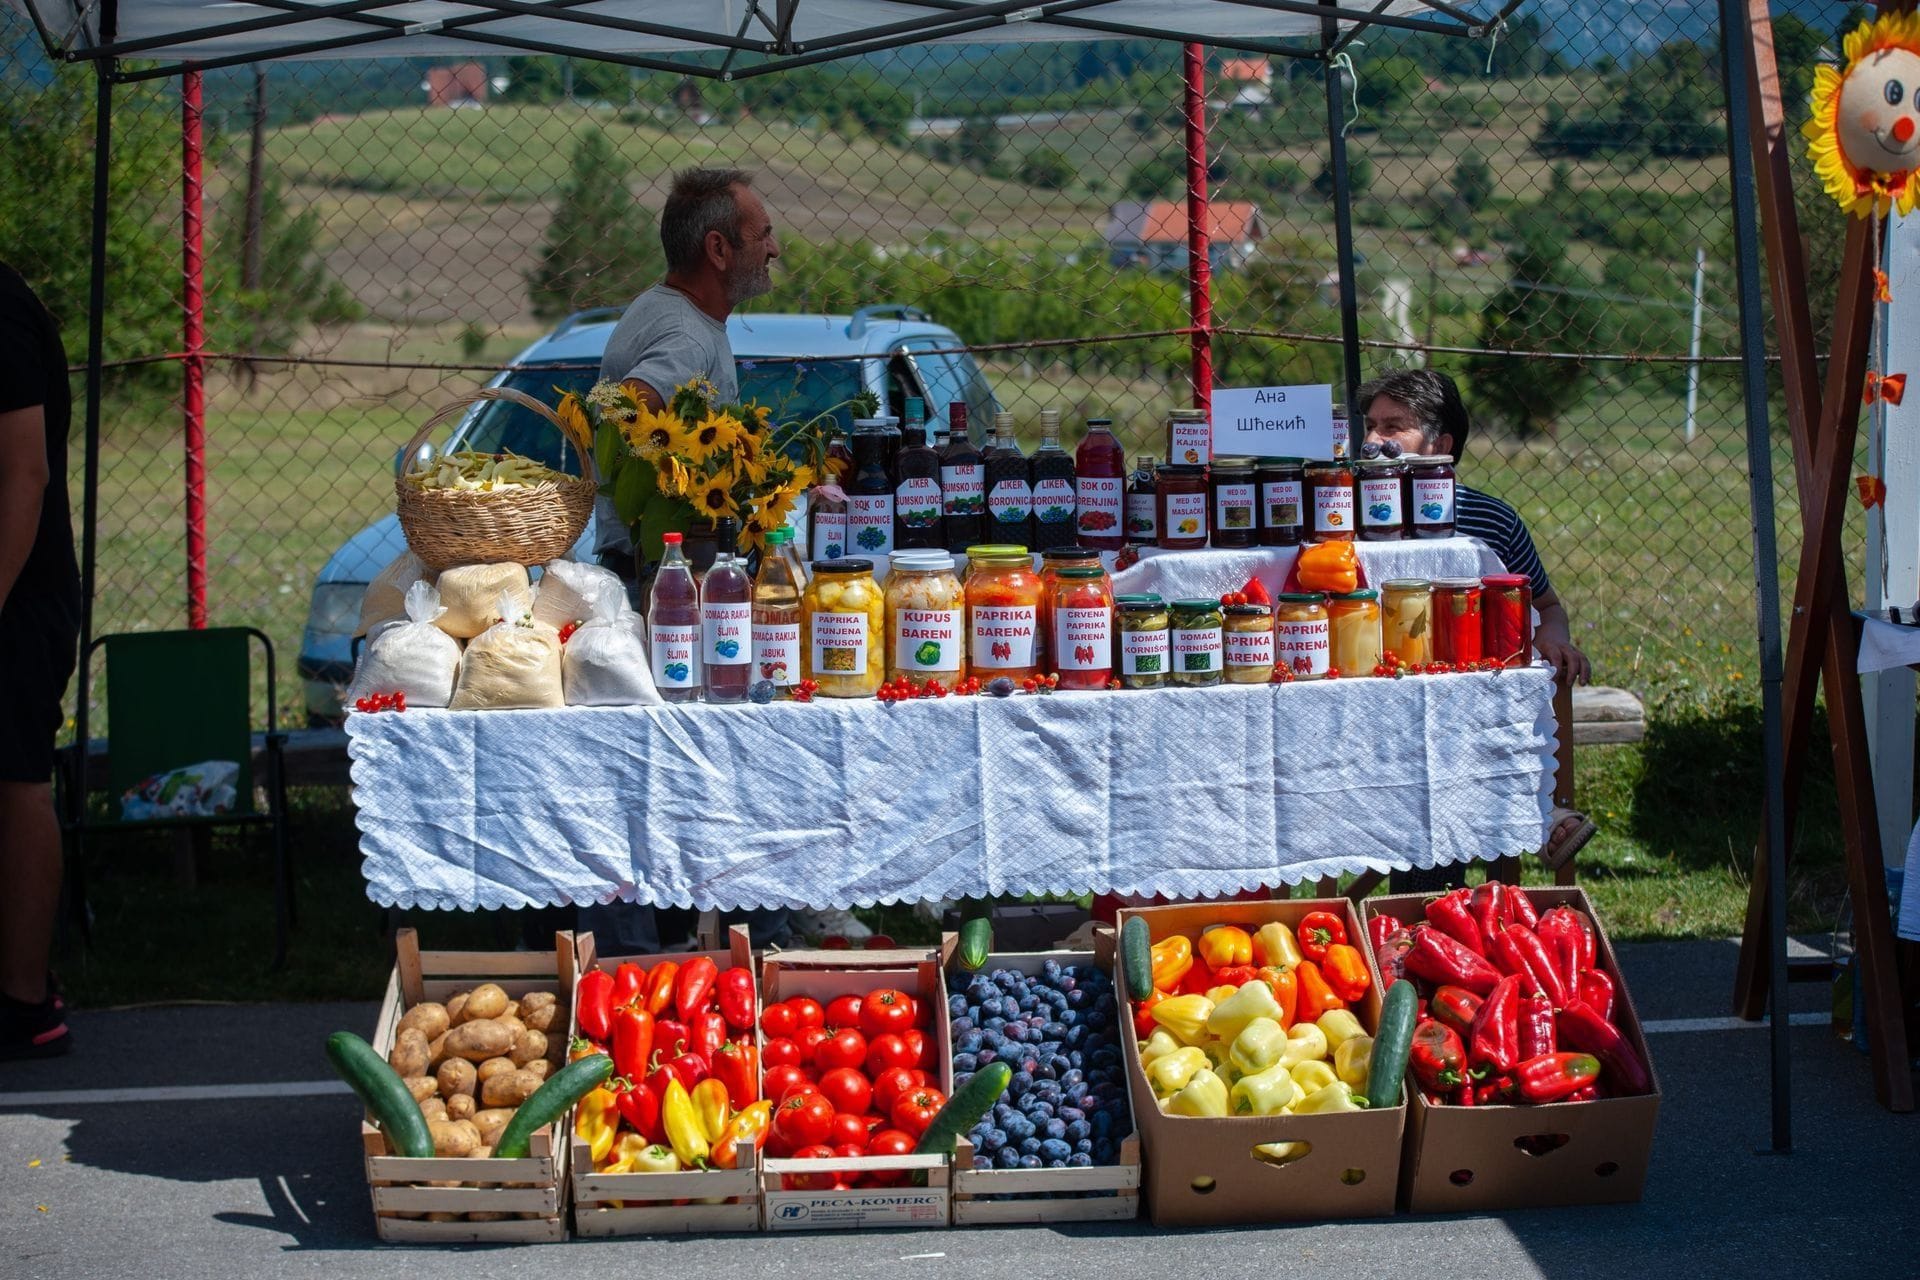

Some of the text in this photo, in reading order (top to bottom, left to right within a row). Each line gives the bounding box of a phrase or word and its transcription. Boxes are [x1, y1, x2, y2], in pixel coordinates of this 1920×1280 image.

[1255, 390, 1286, 404] Ана
[1237, 415, 1306, 431] Шћекић
[1176, 427, 1199, 435] DŽEM
[955, 464, 975, 475] LIKER
[909, 479, 929, 488] LIKER
[1000, 480, 1023, 489] LIKER
[1042, 479, 1065, 489] LIKER
[1081, 482, 1114, 491] SOK OD
[1364, 483, 1388, 491] PEKMEZ
[1417, 482, 1441, 490] PEKMEZ
[1317, 490, 1341, 498] DŽEM
[1371, 493, 1392, 501] ŠLJIVA
[875, 500, 886, 509] OD
[850, 515, 891, 525] BOROVNICE
[705, 608, 730, 620] DOMAĆA
[904, 612, 951, 622] KUPUS
[975, 610, 1032, 620] PAPRIKA
[718, 624, 739, 636] ŠLJIVA
[817, 627, 861, 635] PUNJENA
[902, 628, 952, 639] BARENI
[976, 627, 1031, 637] BARENA
[1278, 623, 1328, 635] PAPRIKA
[655, 632, 680, 643] DOMAĆA
[775, 632, 797, 641] RAKIJA
[1131, 633, 1166, 642] DOMAĆI
[1180, 632, 1216, 641] DOMAĆI
[1224, 636, 1270, 646] APRIKA
[1280, 640, 1328, 651] BARENA
[667, 648, 689, 659] ŠLJIVA
[761, 648, 786, 658] JABUKA
[811, 1196, 938, 1207] PECA-KOMERC
